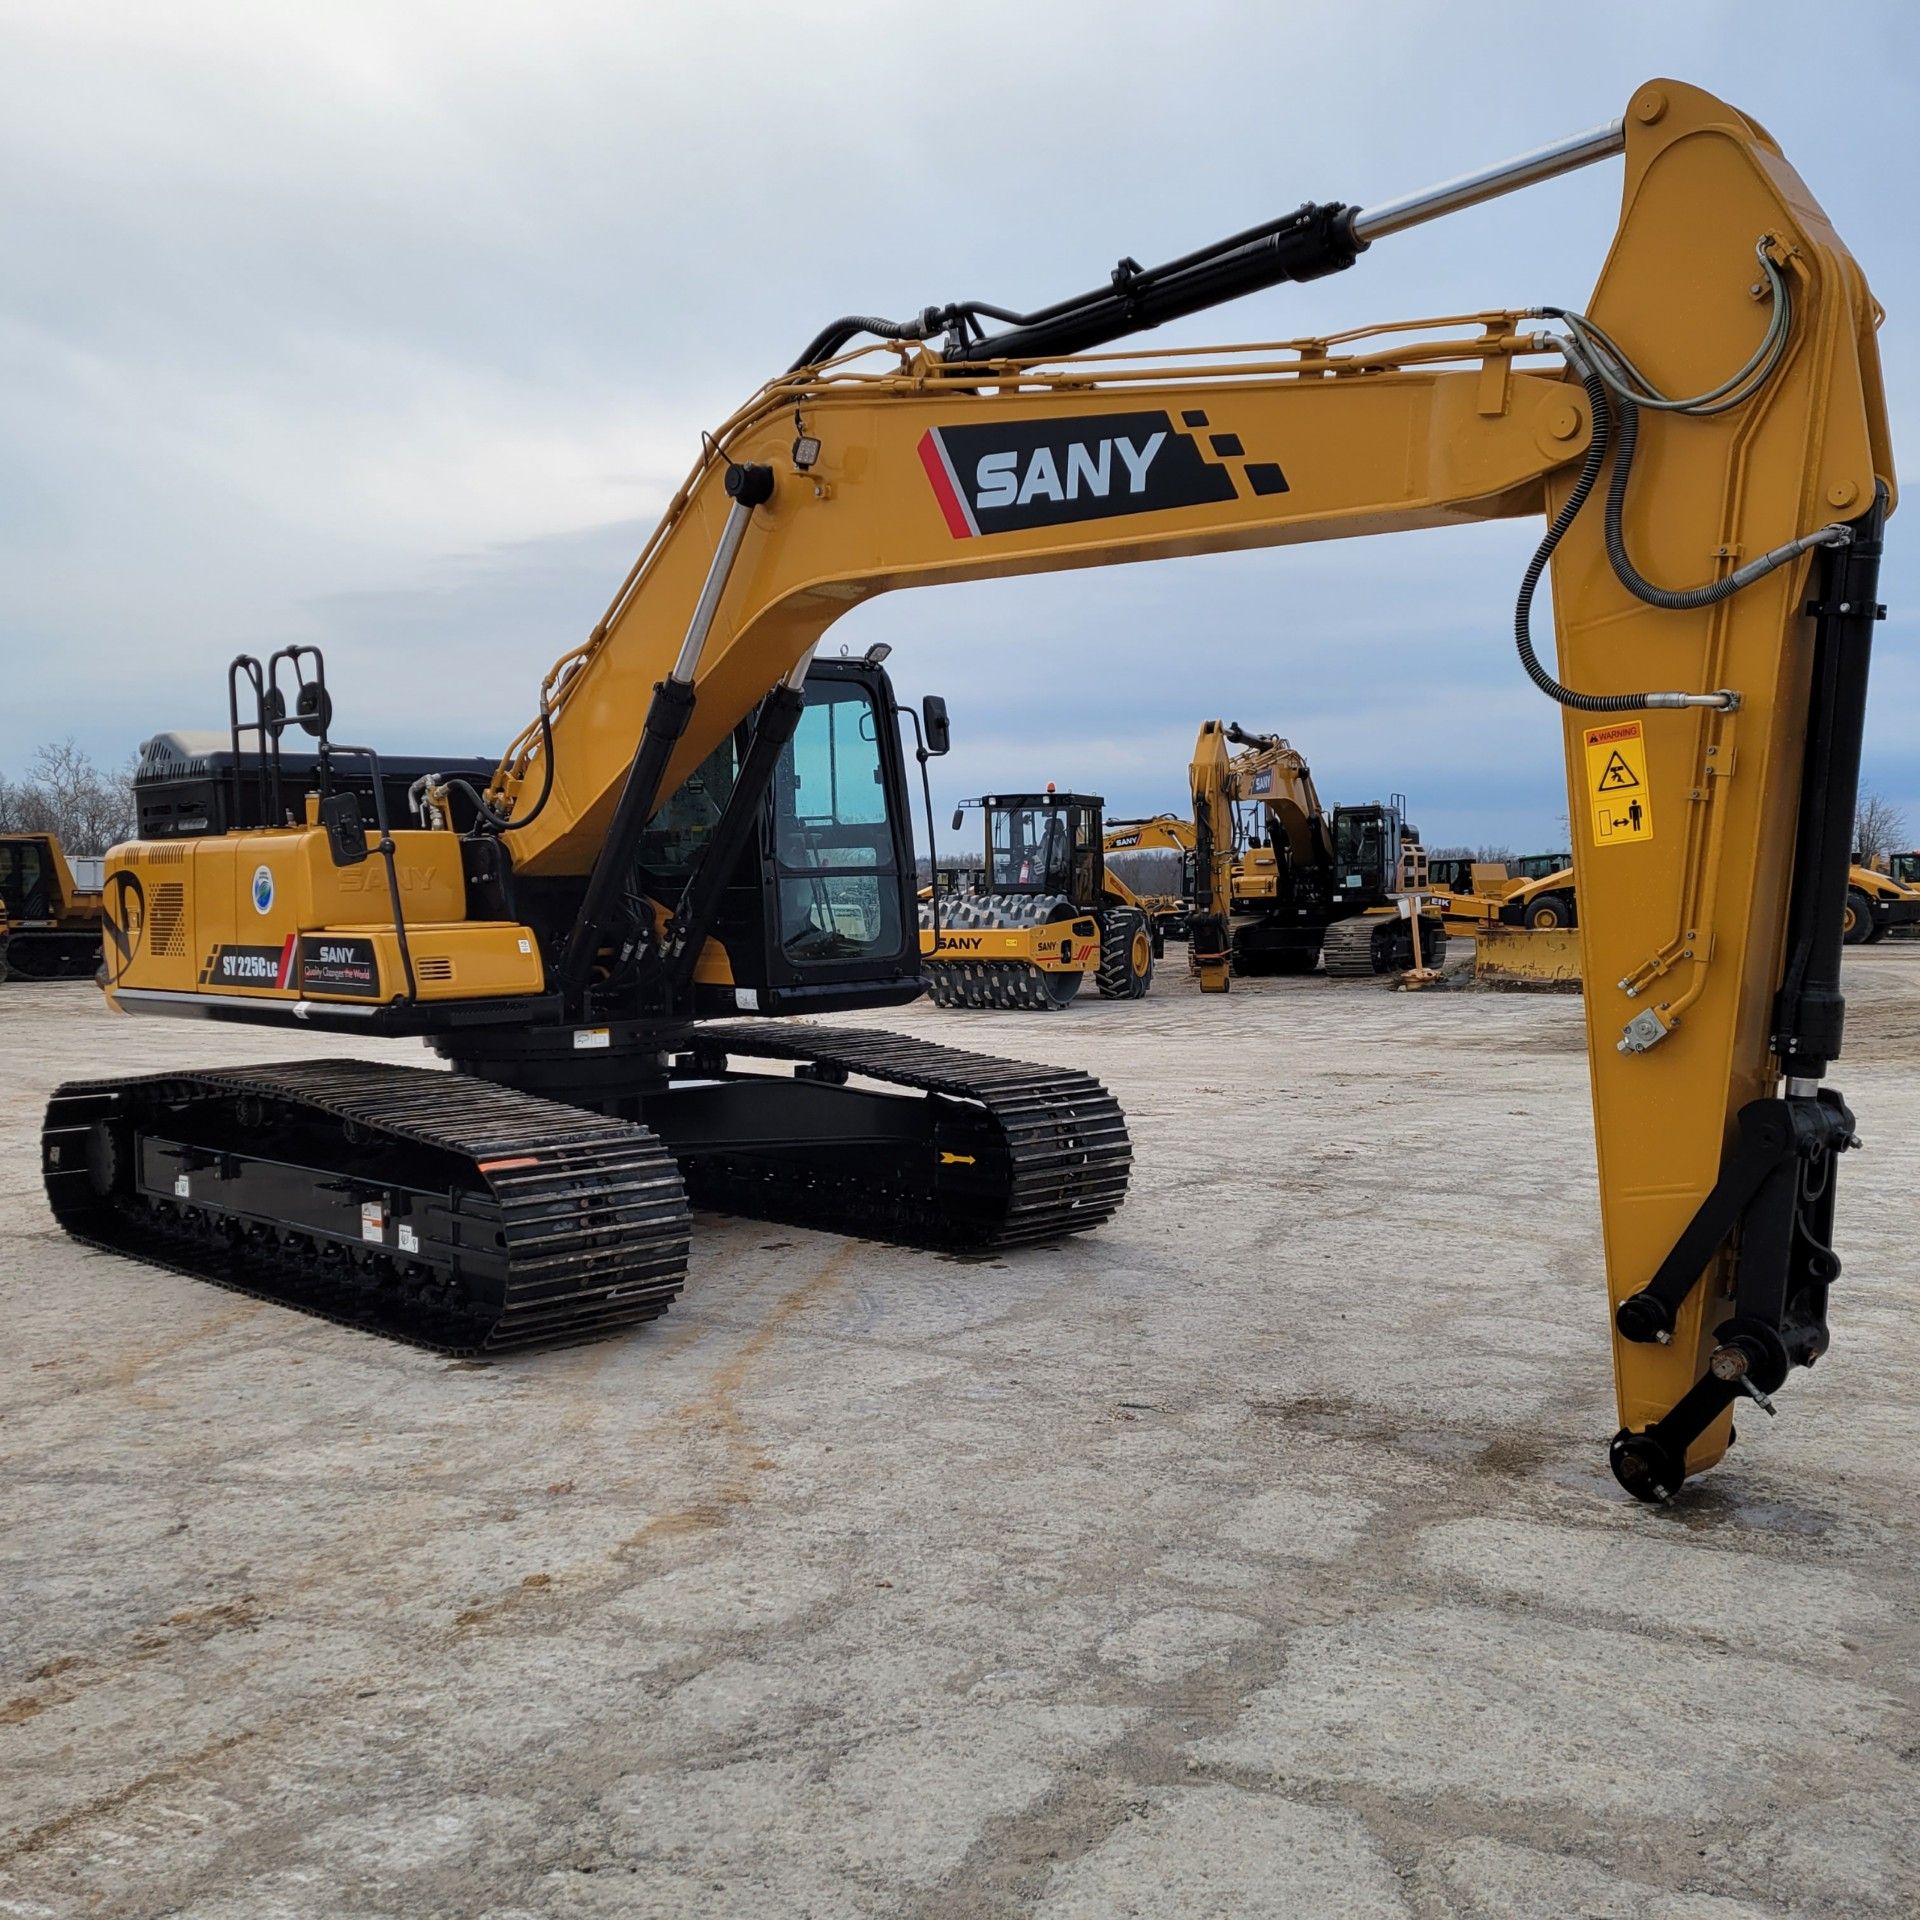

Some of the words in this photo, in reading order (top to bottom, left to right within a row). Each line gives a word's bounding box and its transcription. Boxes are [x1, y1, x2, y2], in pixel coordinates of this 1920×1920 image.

[976, 431, 1167, 509] SANY
[1599, 726, 1637, 741] WARNING
[1115, 836, 1138, 847] SANY
[937, 937, 982, 950] SANY
[1038, 941, 1056, 951] SANY
[320, 946, 354, 963] SANY
